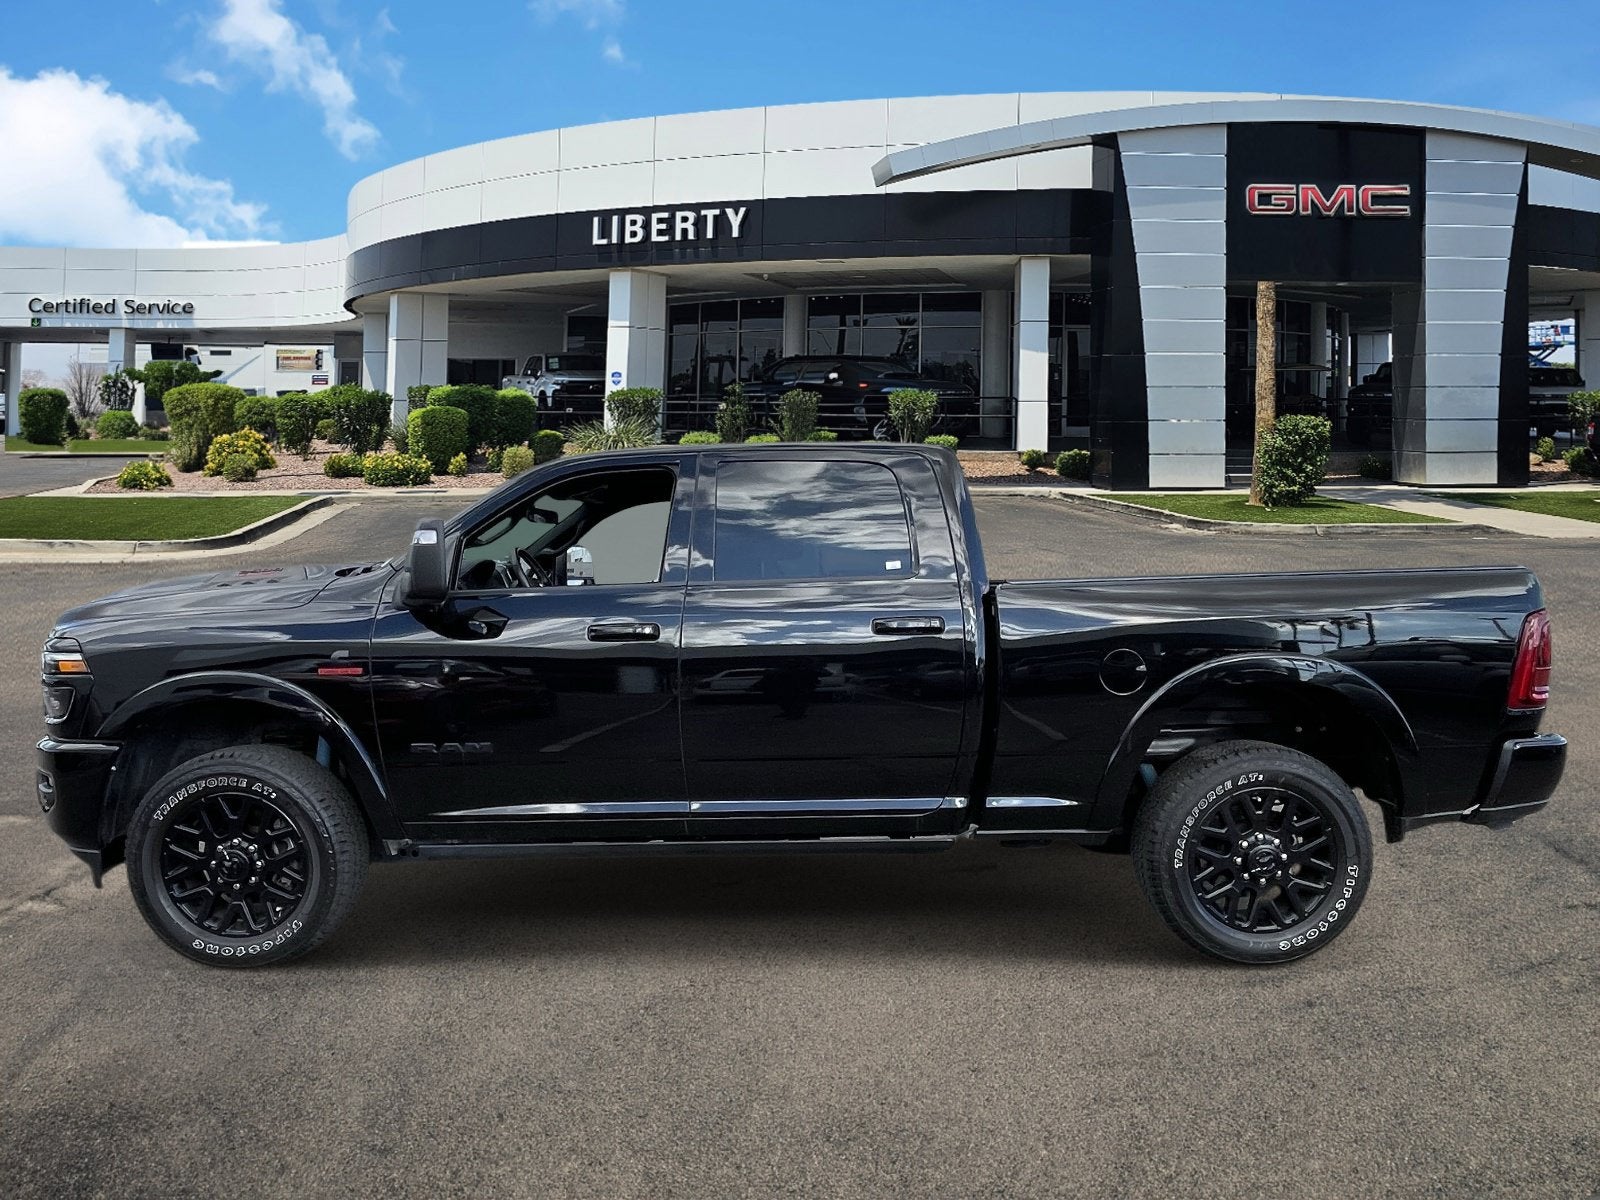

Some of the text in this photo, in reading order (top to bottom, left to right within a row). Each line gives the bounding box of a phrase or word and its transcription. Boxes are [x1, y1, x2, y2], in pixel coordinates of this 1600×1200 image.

[1246, 183, 1411, 216] GMC
[592, 207, 747, 246] LIBERTY
[28, 297, 194, 315] Certified Service
[410, 742, 494, 753] RAM
[153, 776, 248, 822] TRANSFORCE
[1174, 780, 1233, 869] TRANSFORCE
